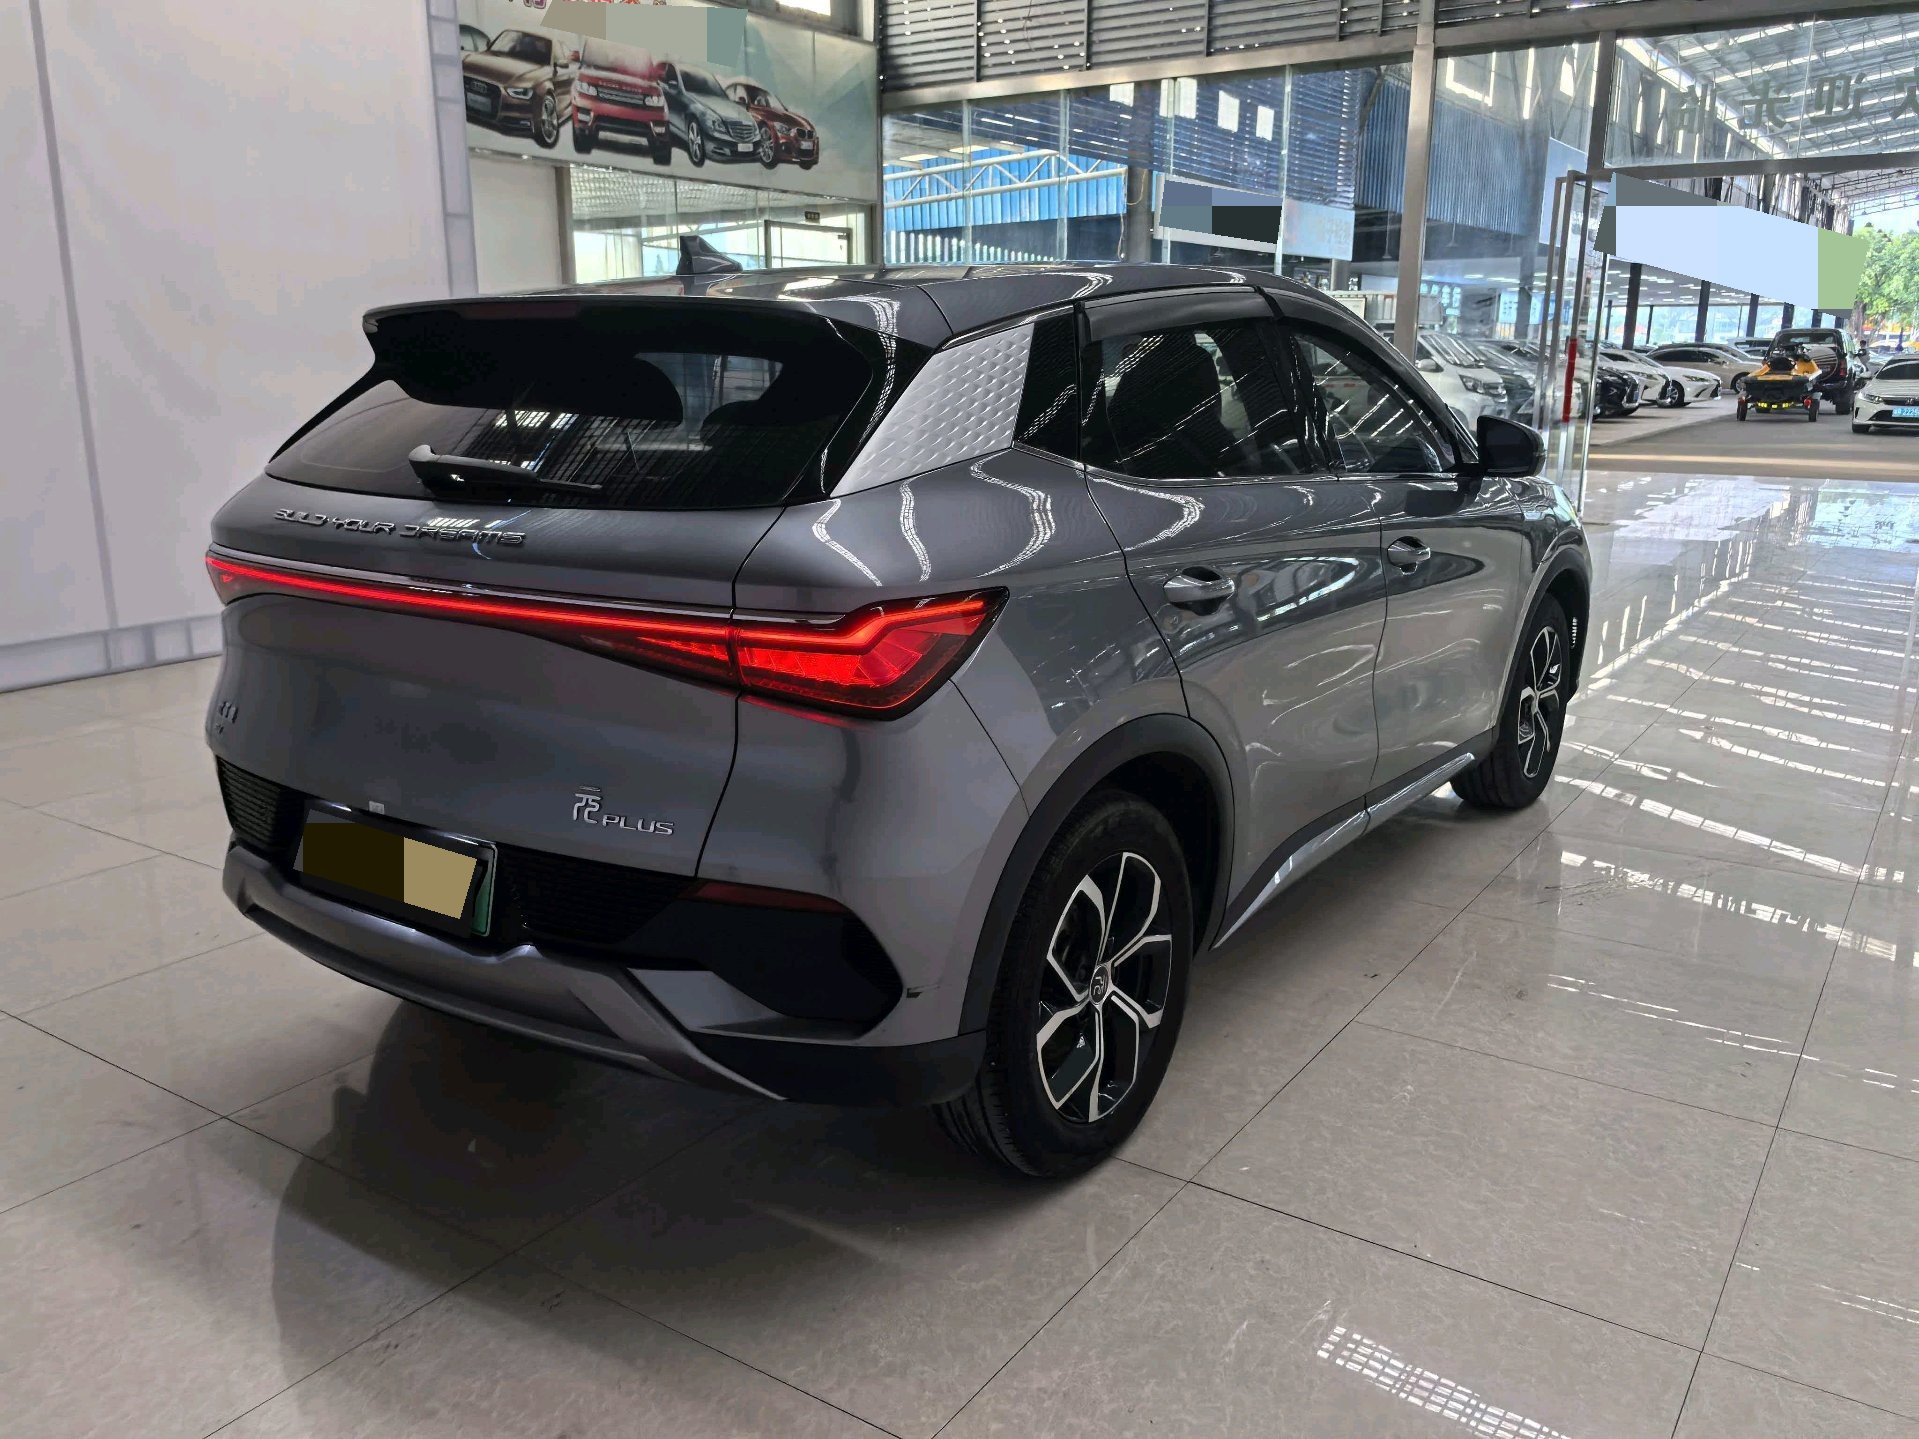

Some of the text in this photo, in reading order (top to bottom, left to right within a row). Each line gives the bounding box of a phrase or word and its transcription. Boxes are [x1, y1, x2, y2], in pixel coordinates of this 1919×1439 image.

[332, 516, 397, 536] YOUR
[400, 524, 527, 546] DREAMS
[602, 814, 675, 836] PLUS
